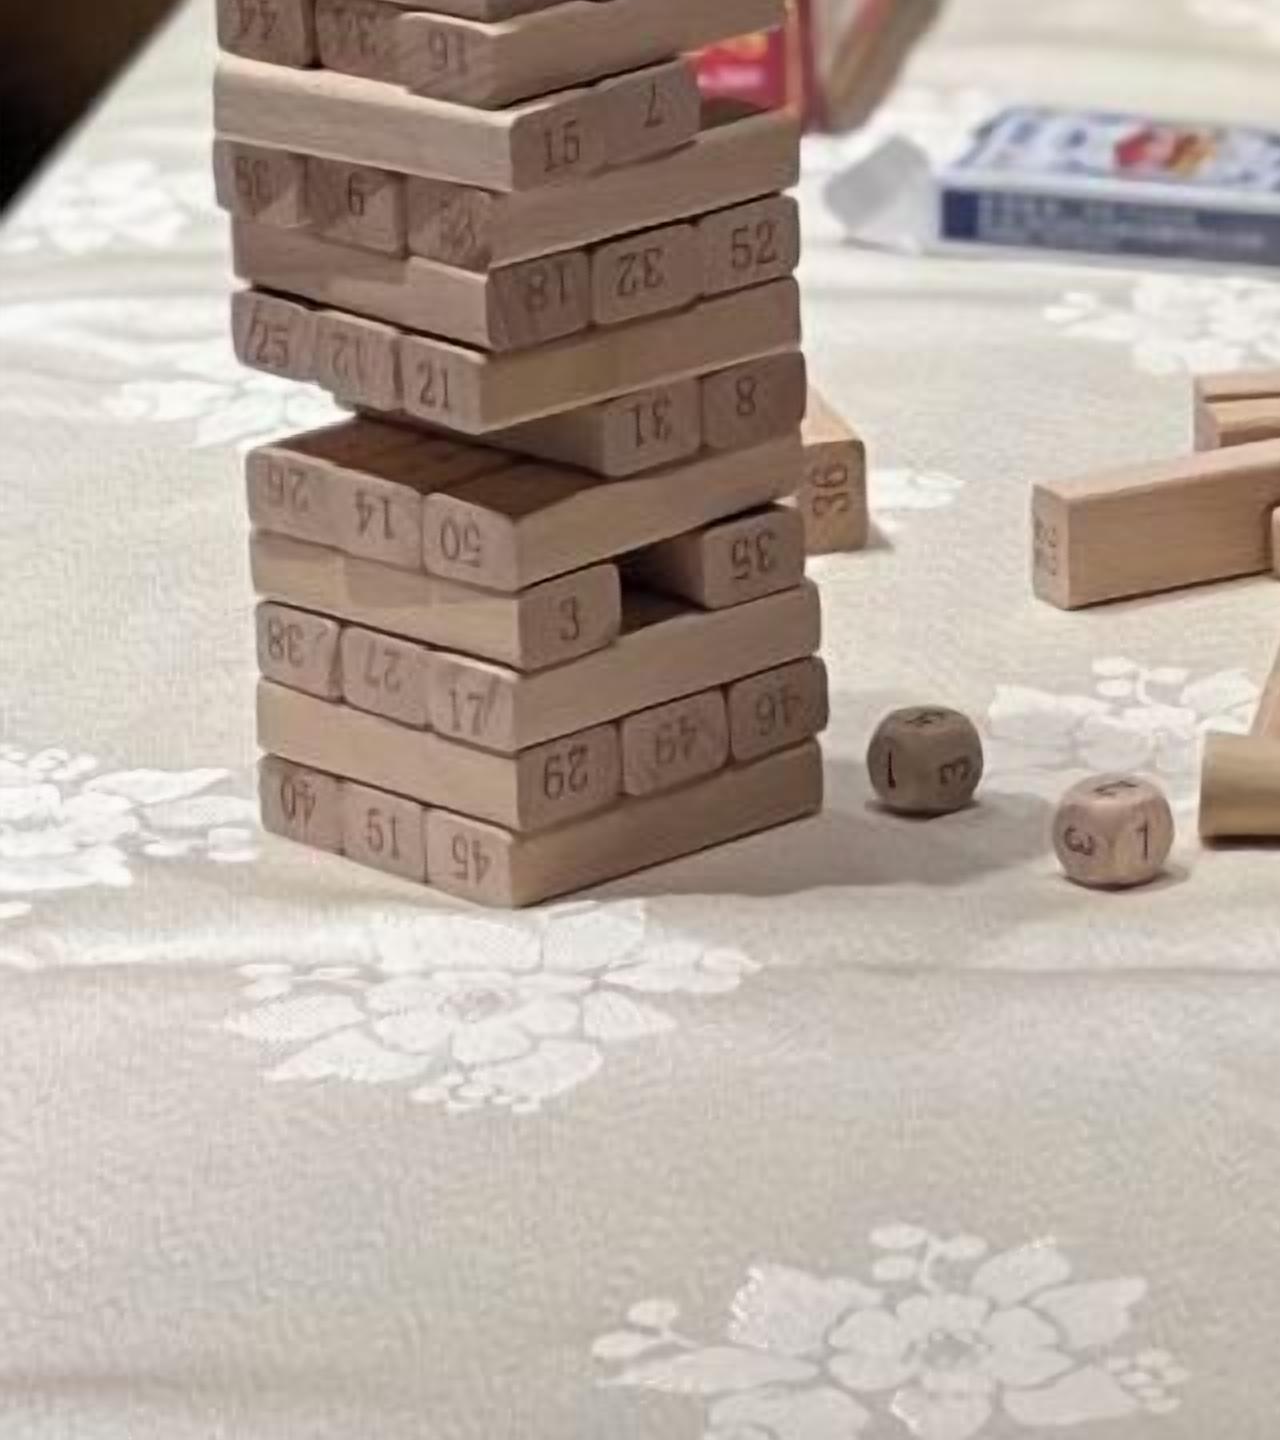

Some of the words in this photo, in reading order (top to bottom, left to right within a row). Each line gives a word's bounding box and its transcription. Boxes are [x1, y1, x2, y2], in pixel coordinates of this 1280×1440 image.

[731, 218, 778, 271] 52
[416, 360, 450, 410] 21
[735, 375, 757, 417] 8
[811, 462, 850, 518] 36
[439, 515, 482, 568] 50
[543, 743, 589, 800] 29
[1136, 819, 1149, 860] 1
